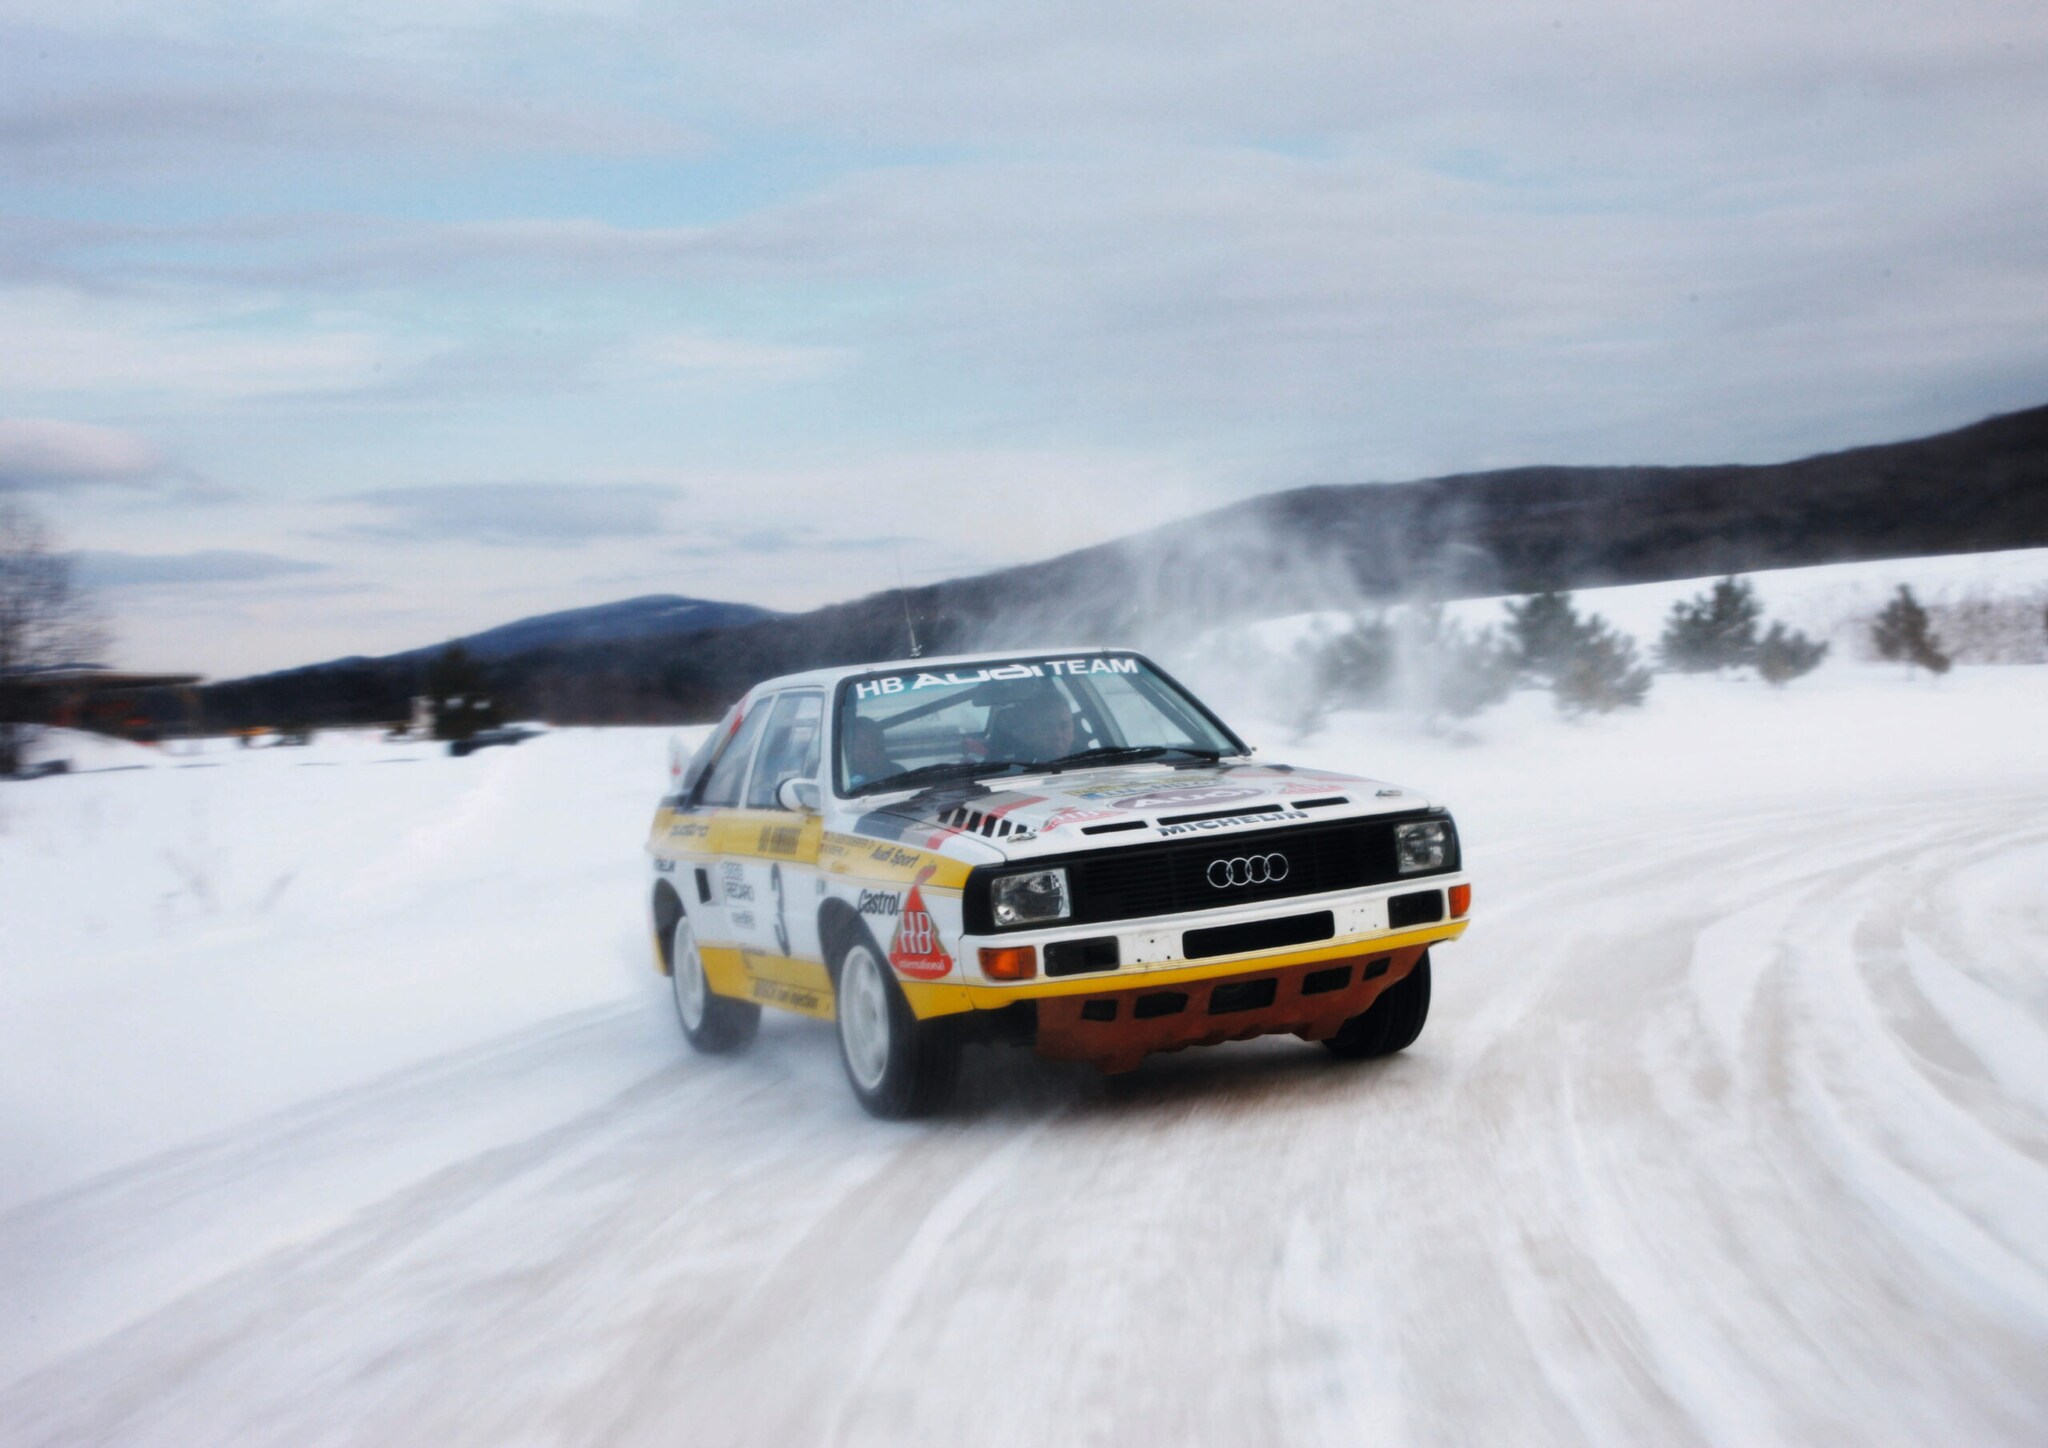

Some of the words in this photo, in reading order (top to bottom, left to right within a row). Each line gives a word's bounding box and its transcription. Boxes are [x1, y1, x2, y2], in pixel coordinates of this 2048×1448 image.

[855, 676, 904, 699] HB
[1045, 658, 1139, 676] TEAM
[1156, 810, 1309, 837] MICHELIN
[889, 849, 921, 869] Sport
[857, 887, 902, 917] Castrol
[900, 910, 933, 955] HB
